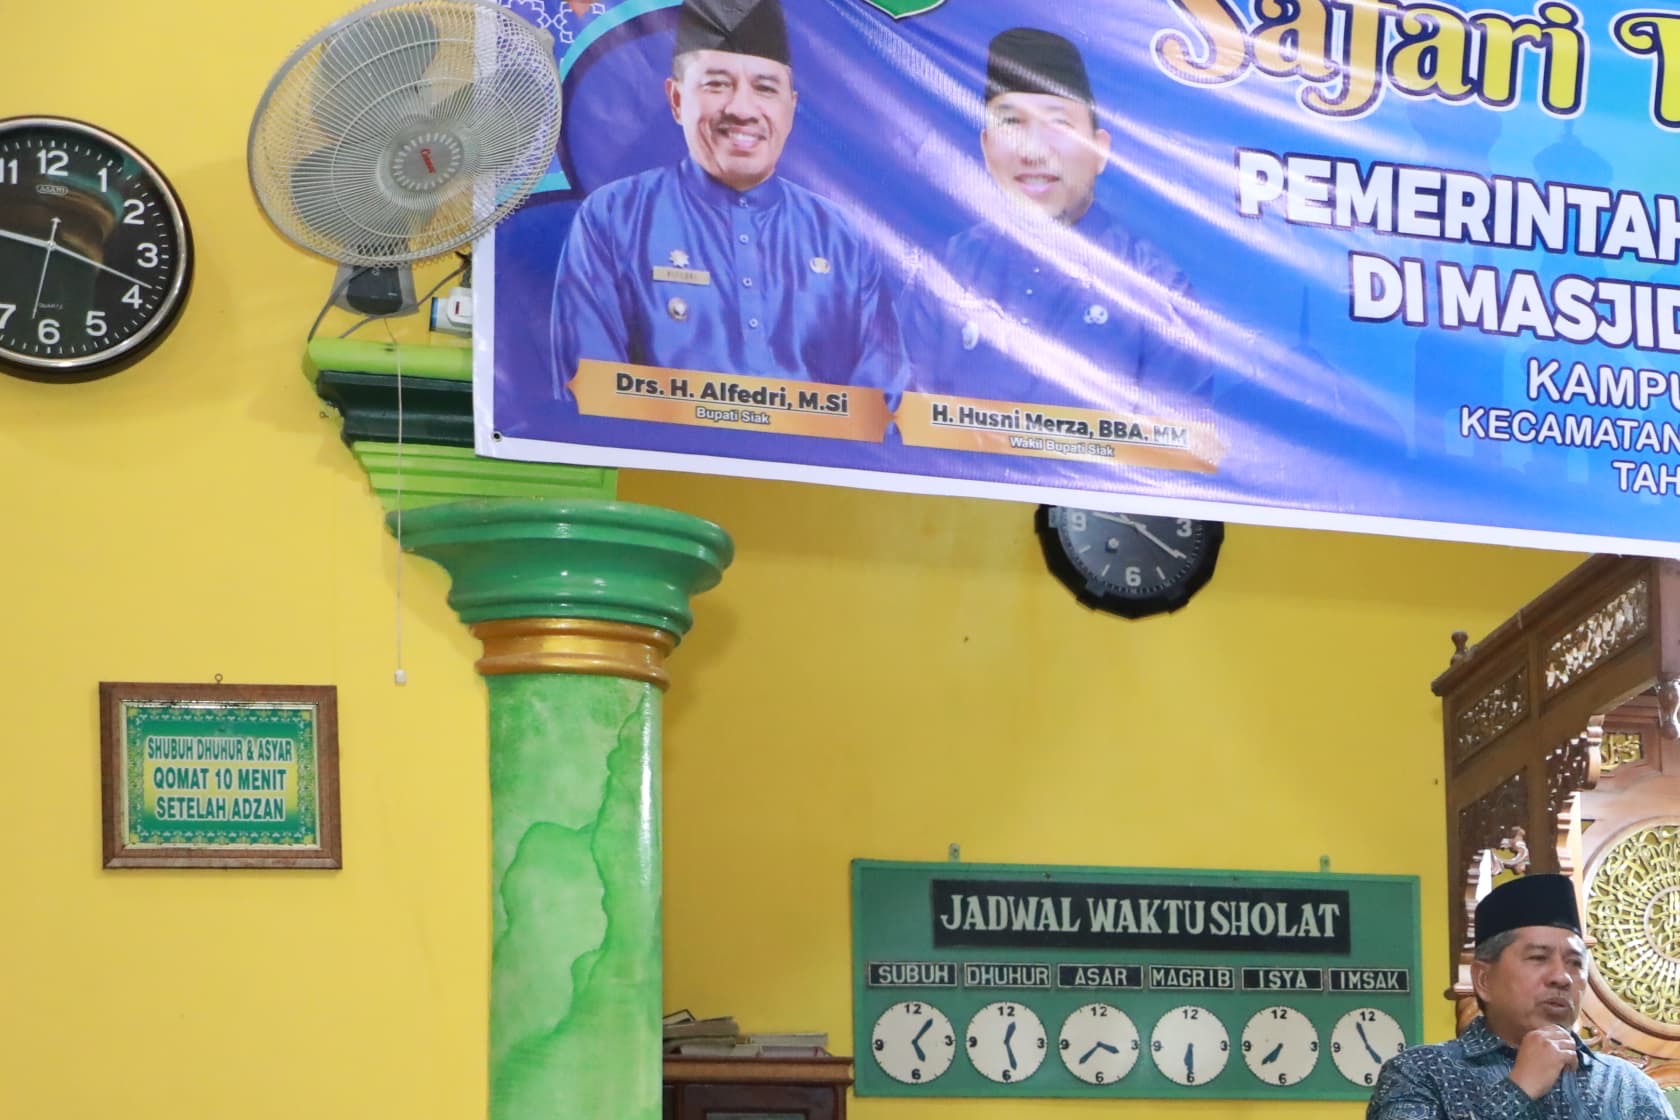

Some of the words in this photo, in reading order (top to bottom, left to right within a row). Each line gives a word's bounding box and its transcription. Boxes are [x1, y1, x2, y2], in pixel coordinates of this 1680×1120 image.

[37, 149, 69, 177] 12
[97, 167, 108, 193] 1
[123, 199, 145, 225] 2
[137, 242, 159, 268] 3
[121, 284, 143, 309] 4
[1348, 250, 1428, 327] DI
[0, 303, 17, 329] 7
[86, 310, 107, 336] 5
[37, 319, 61, 344] 6
[616, 372, 664, 396] Drs.
[670, 378, 694, 399] H.
[701, 380, 792, 411] Alfedri,
[798, 390, 849, 414] M.Si
[695, 406, 738, 424] Bupati
[741, 410, 770, 425] Siak
[930, 403, 954, 424] H.
[959, 405, 1021, 430] Husni
[1024, 412, 1094, 440] Merza,
[1098, 418, 1149, 442] BBA.
[1010, 436, 1043, 451] Wakil
[1045, 439, 1087, 455] Bupati
[1088, 443, 1116, 458] Siak
[1071, 512, 1087, 532] 9
[1175, 518, 1192, 538] 3
[1125, 566, 1142, 587] 6
[147, 737, 194, 760] SHUBUH
[197, 738, 243, 761] DHUHUR
[246, 739, 255, 761] &
[257, 739, 293, 762] ASYAR
[153, 767, 209, 790] QOMAT
[215, 768, 233, 790] 10
[238, 769, 287, 791] MENIT
[156, 796, 226, 820] SETELAH
[231, 798, 284, 820] ADZAN
[940, 894, 1081, 932] JADWAL
[878, 965, 950, 986] SUBUH
[966, 966, 1050, 987] DHUHUR
[1074, 968, 1128, 987] ASAR
[1151, 968, 1233, 989] MAGRIB
[1258, 970, 1309, 990] ISYA
[1340, 970, 1400, 991] IMSAK
[904, 1004, 922, 1015] 12
[998, 1006, 1015, 1017] 12
[1091, 1006, 1108, 1017] 12
[1182, 1009, 1199, 1020] 12
[1271, 1009, 1287, 1020] 12
[1359, 1011, 1376, 1022] 12
[874, 1039, 884, 1051] 9
[944, 1035, 953, 1046] 3
[969, 1036, 978, 1048] 9
[1036, 1038, 1045, 1049] 3
[1060, 1039, 1069, 1050] 9
[1131, 1040, 1139, 1050] 3
[1153, 1040, 1161, 1051] 9
[1220, 1041, 1228, 1051] 3
[1243, 1040, 1252, 1052] 9
[1310, 1041, 1318, 1052] 3
[1333, 1042, 1341, 1053] 9
[911, 1068, 921, 1080] 6
[1002, 1069, 1011, 1081] 6
[1095, 1072, 1104, 1083] 6
[1186, 1072, 1195, 1083] 6
[1278, 1073, 1287, 1085] 6
[1364, 1073, 1373, 1085] 6
